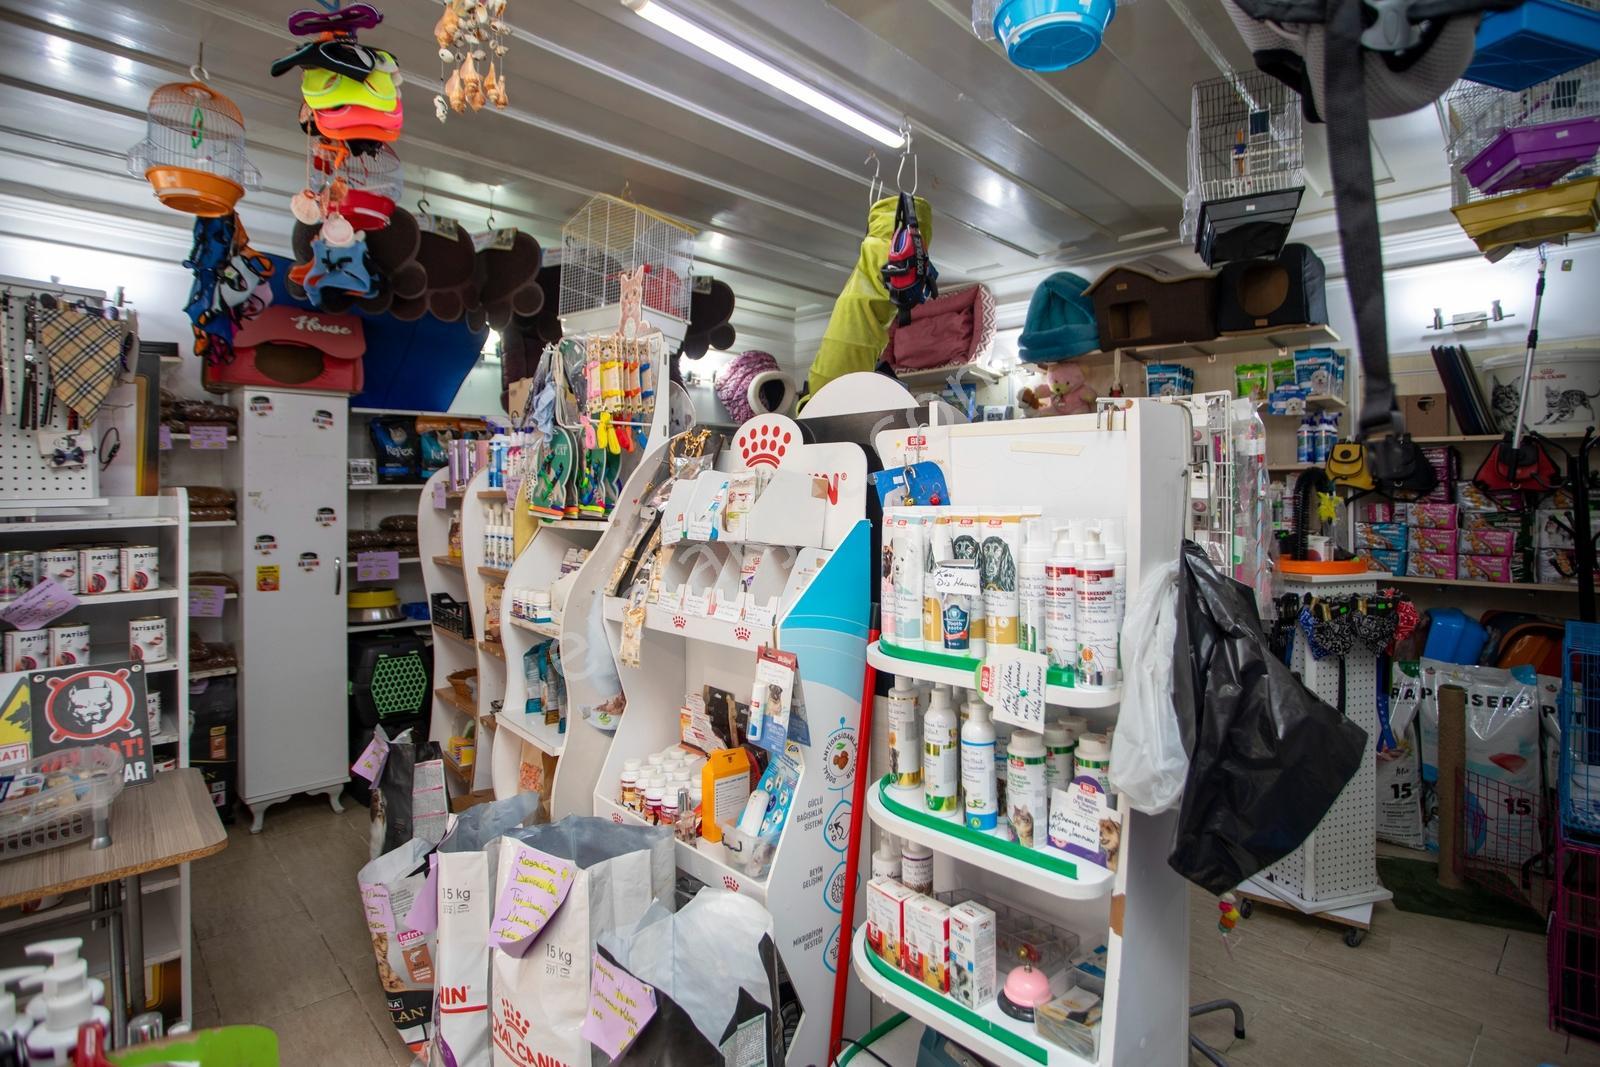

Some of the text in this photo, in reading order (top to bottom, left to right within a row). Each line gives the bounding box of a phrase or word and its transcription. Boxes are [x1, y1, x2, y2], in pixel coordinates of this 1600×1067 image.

[290, 314, 352, 336] House
[1391, 783, 1412, 798] 15
[1504, 798, 1532, 816] 15
[442, 888, 471, 901] 15 kg
[546, 944, 572, 964] 15 kg
[439, 986, 466, 1005] NIN
[391, 1008, 424, 1024] LAN
